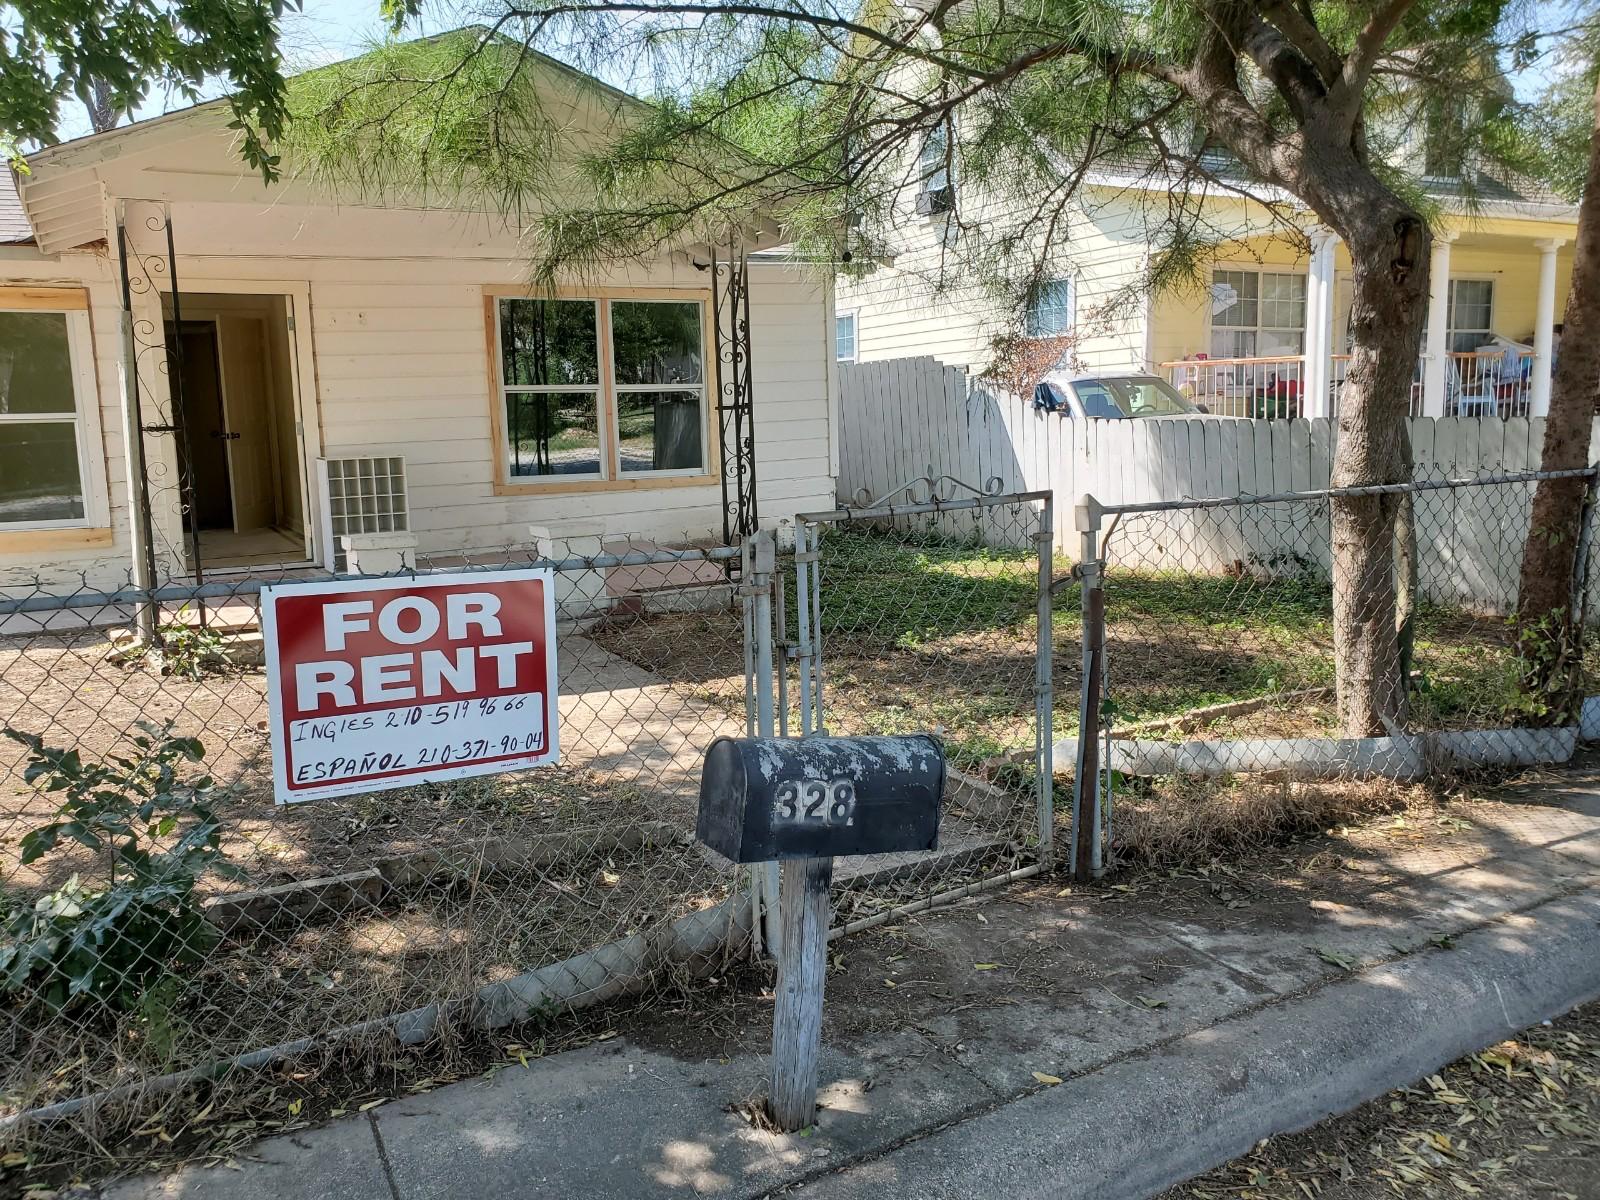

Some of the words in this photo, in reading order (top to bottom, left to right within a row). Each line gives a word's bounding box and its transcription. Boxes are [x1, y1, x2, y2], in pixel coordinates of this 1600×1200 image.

[322, 592, 503, 652] FOR
[295, 641, 533, 712] RENT
[480, 697, 496, 717] 96
[504, 696, 528, 712] 66
[297, 752, 406, 781] ESPAÑOL
[418, 731, 543, 764] 210-371-90-04
[777, 782, 853, 825] 328
